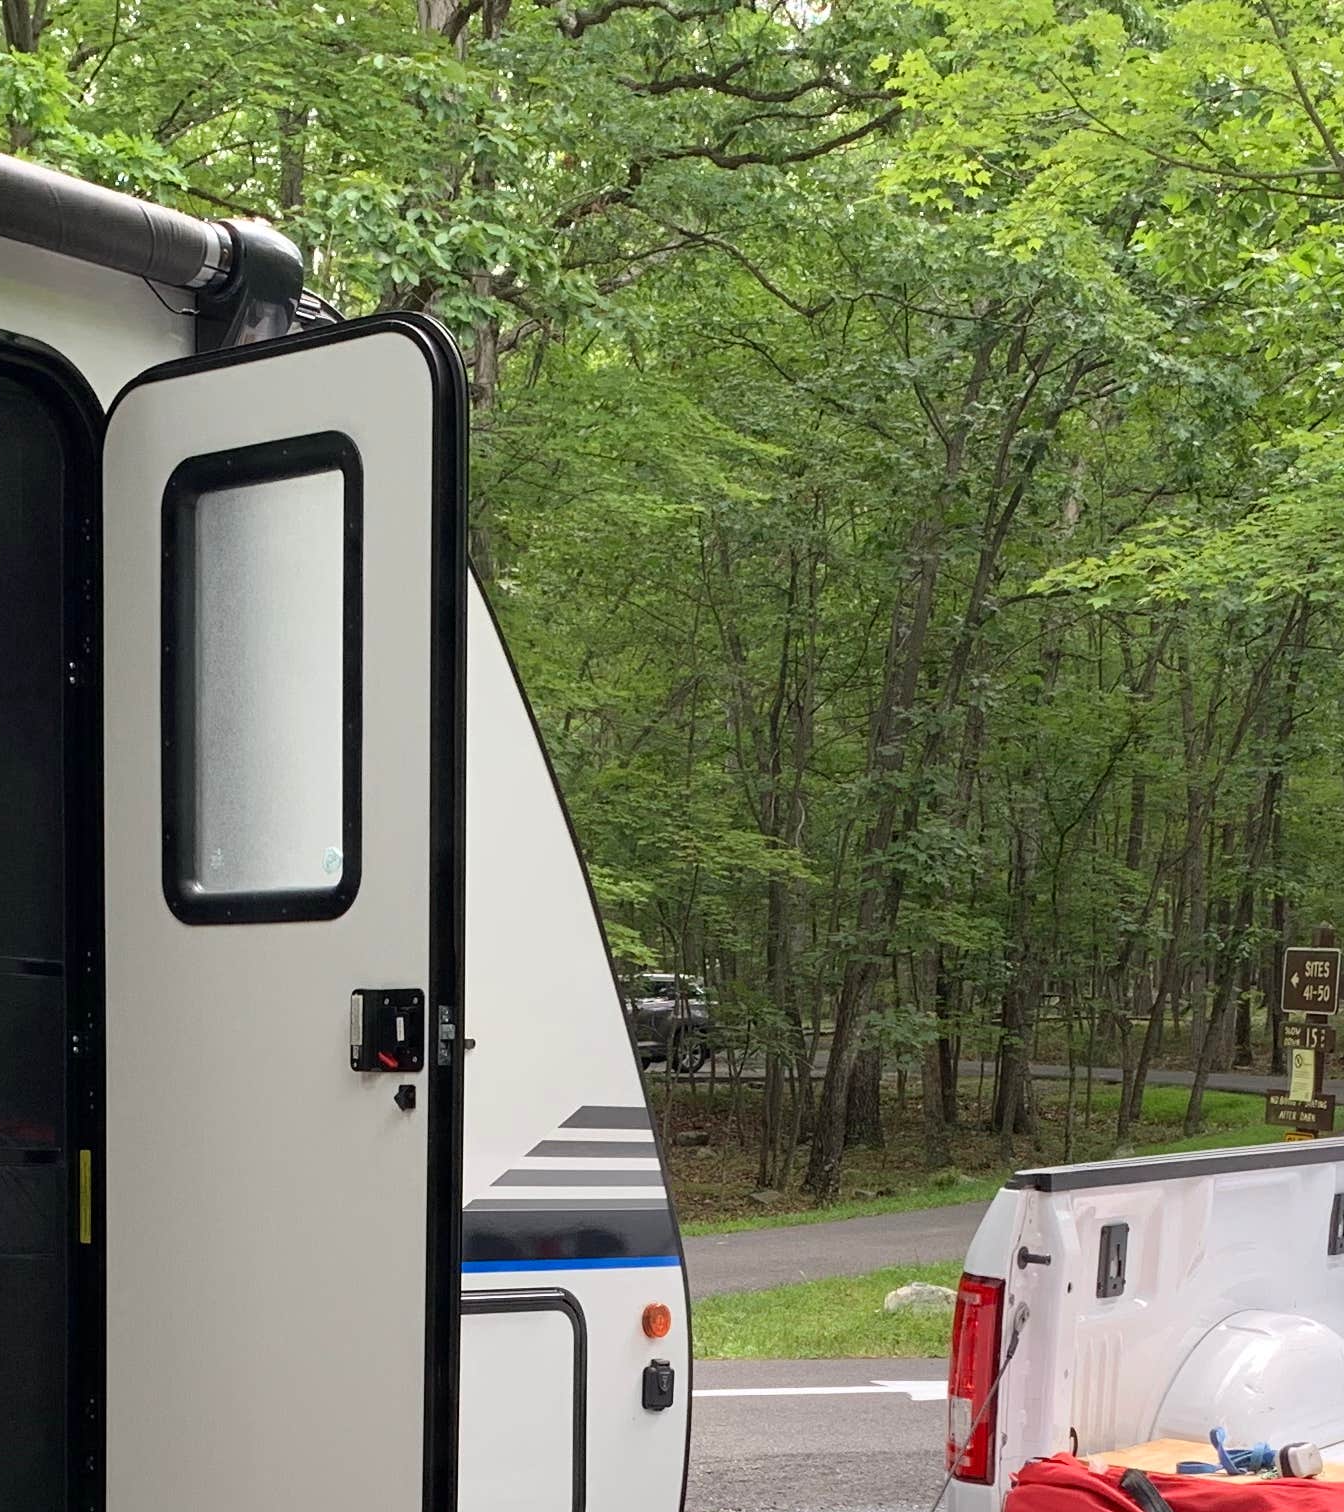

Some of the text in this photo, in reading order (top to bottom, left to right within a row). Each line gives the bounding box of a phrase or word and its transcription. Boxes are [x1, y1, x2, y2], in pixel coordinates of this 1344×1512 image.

[1305, 961, 1330, 978] SITES
[1303, 984, 1331, 1002] 41-50
[1306, 1027, 1318, 1048] 15
